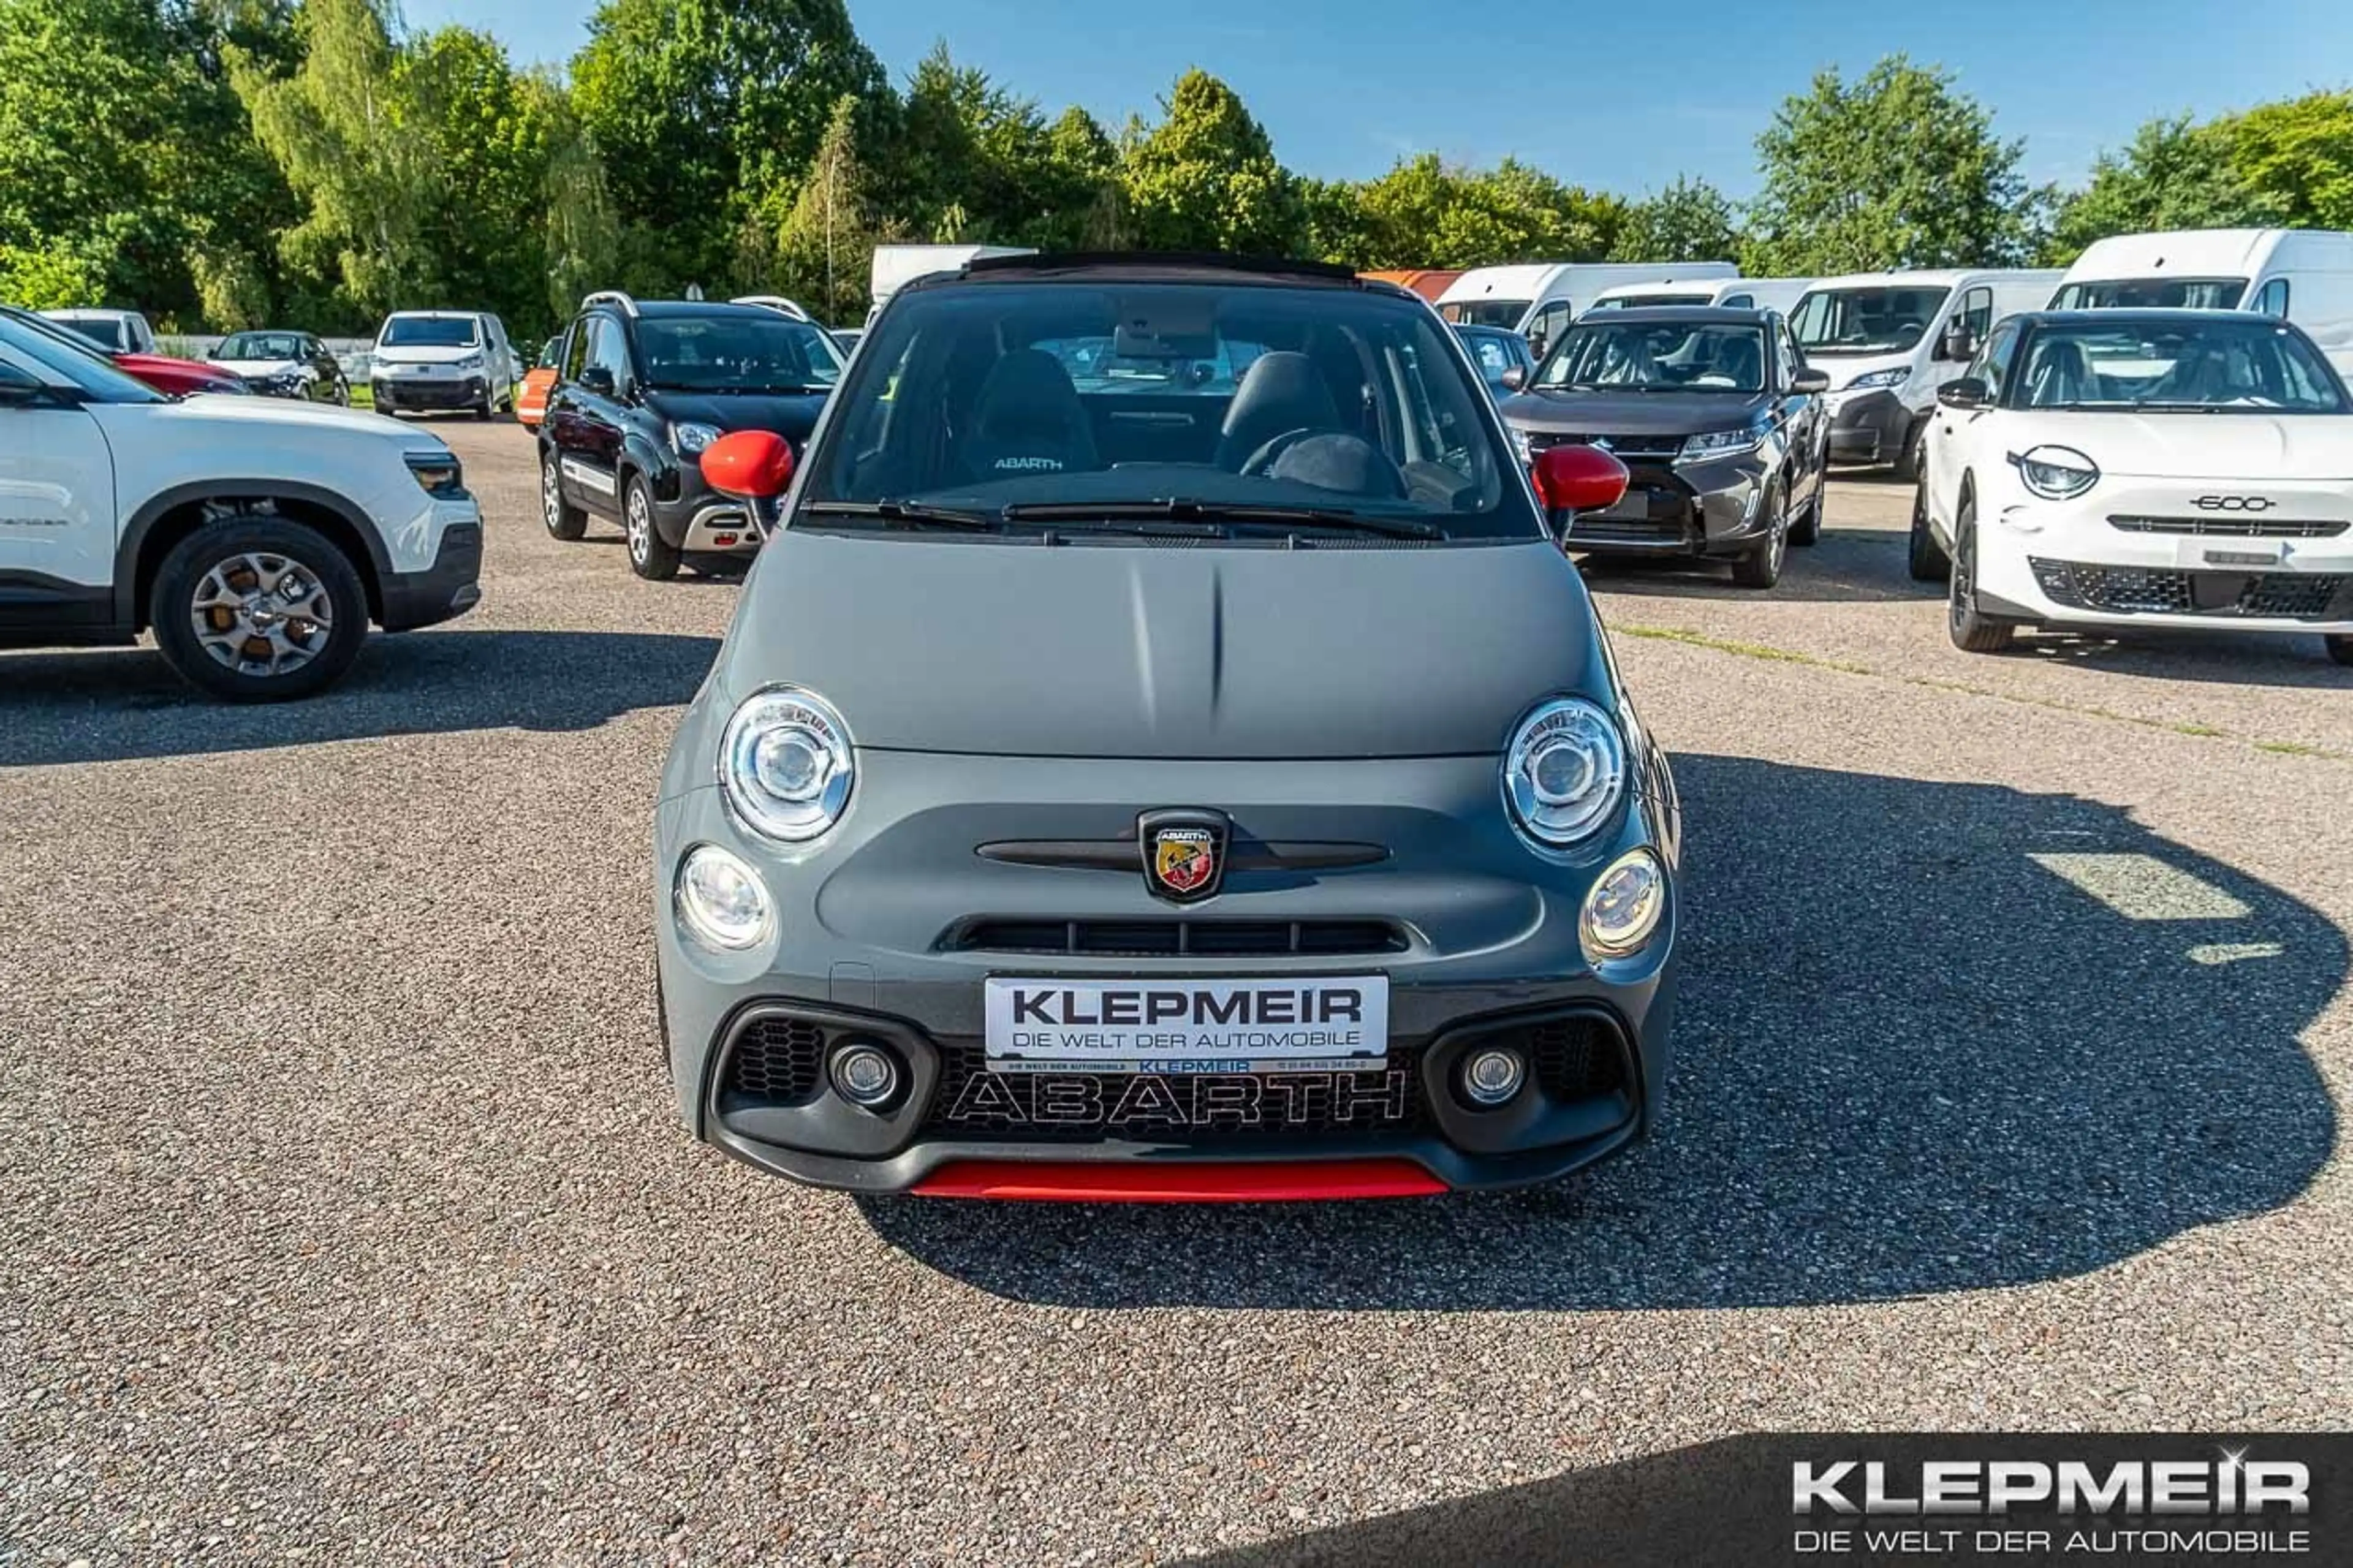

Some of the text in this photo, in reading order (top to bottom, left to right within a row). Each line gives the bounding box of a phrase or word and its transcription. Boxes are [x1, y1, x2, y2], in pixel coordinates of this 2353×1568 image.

[995, 457, 1063, 471] ABARTH
[1013, 989, 1362, 1025] KLEPMEIR
[1012, 1031, 1360, 1049] DIE WELT DER AUTOMOBILE
[1139, 1059, 1251, 1072] KLEPMEIR
[948, 1071, 1405, 1124] ABARTH
